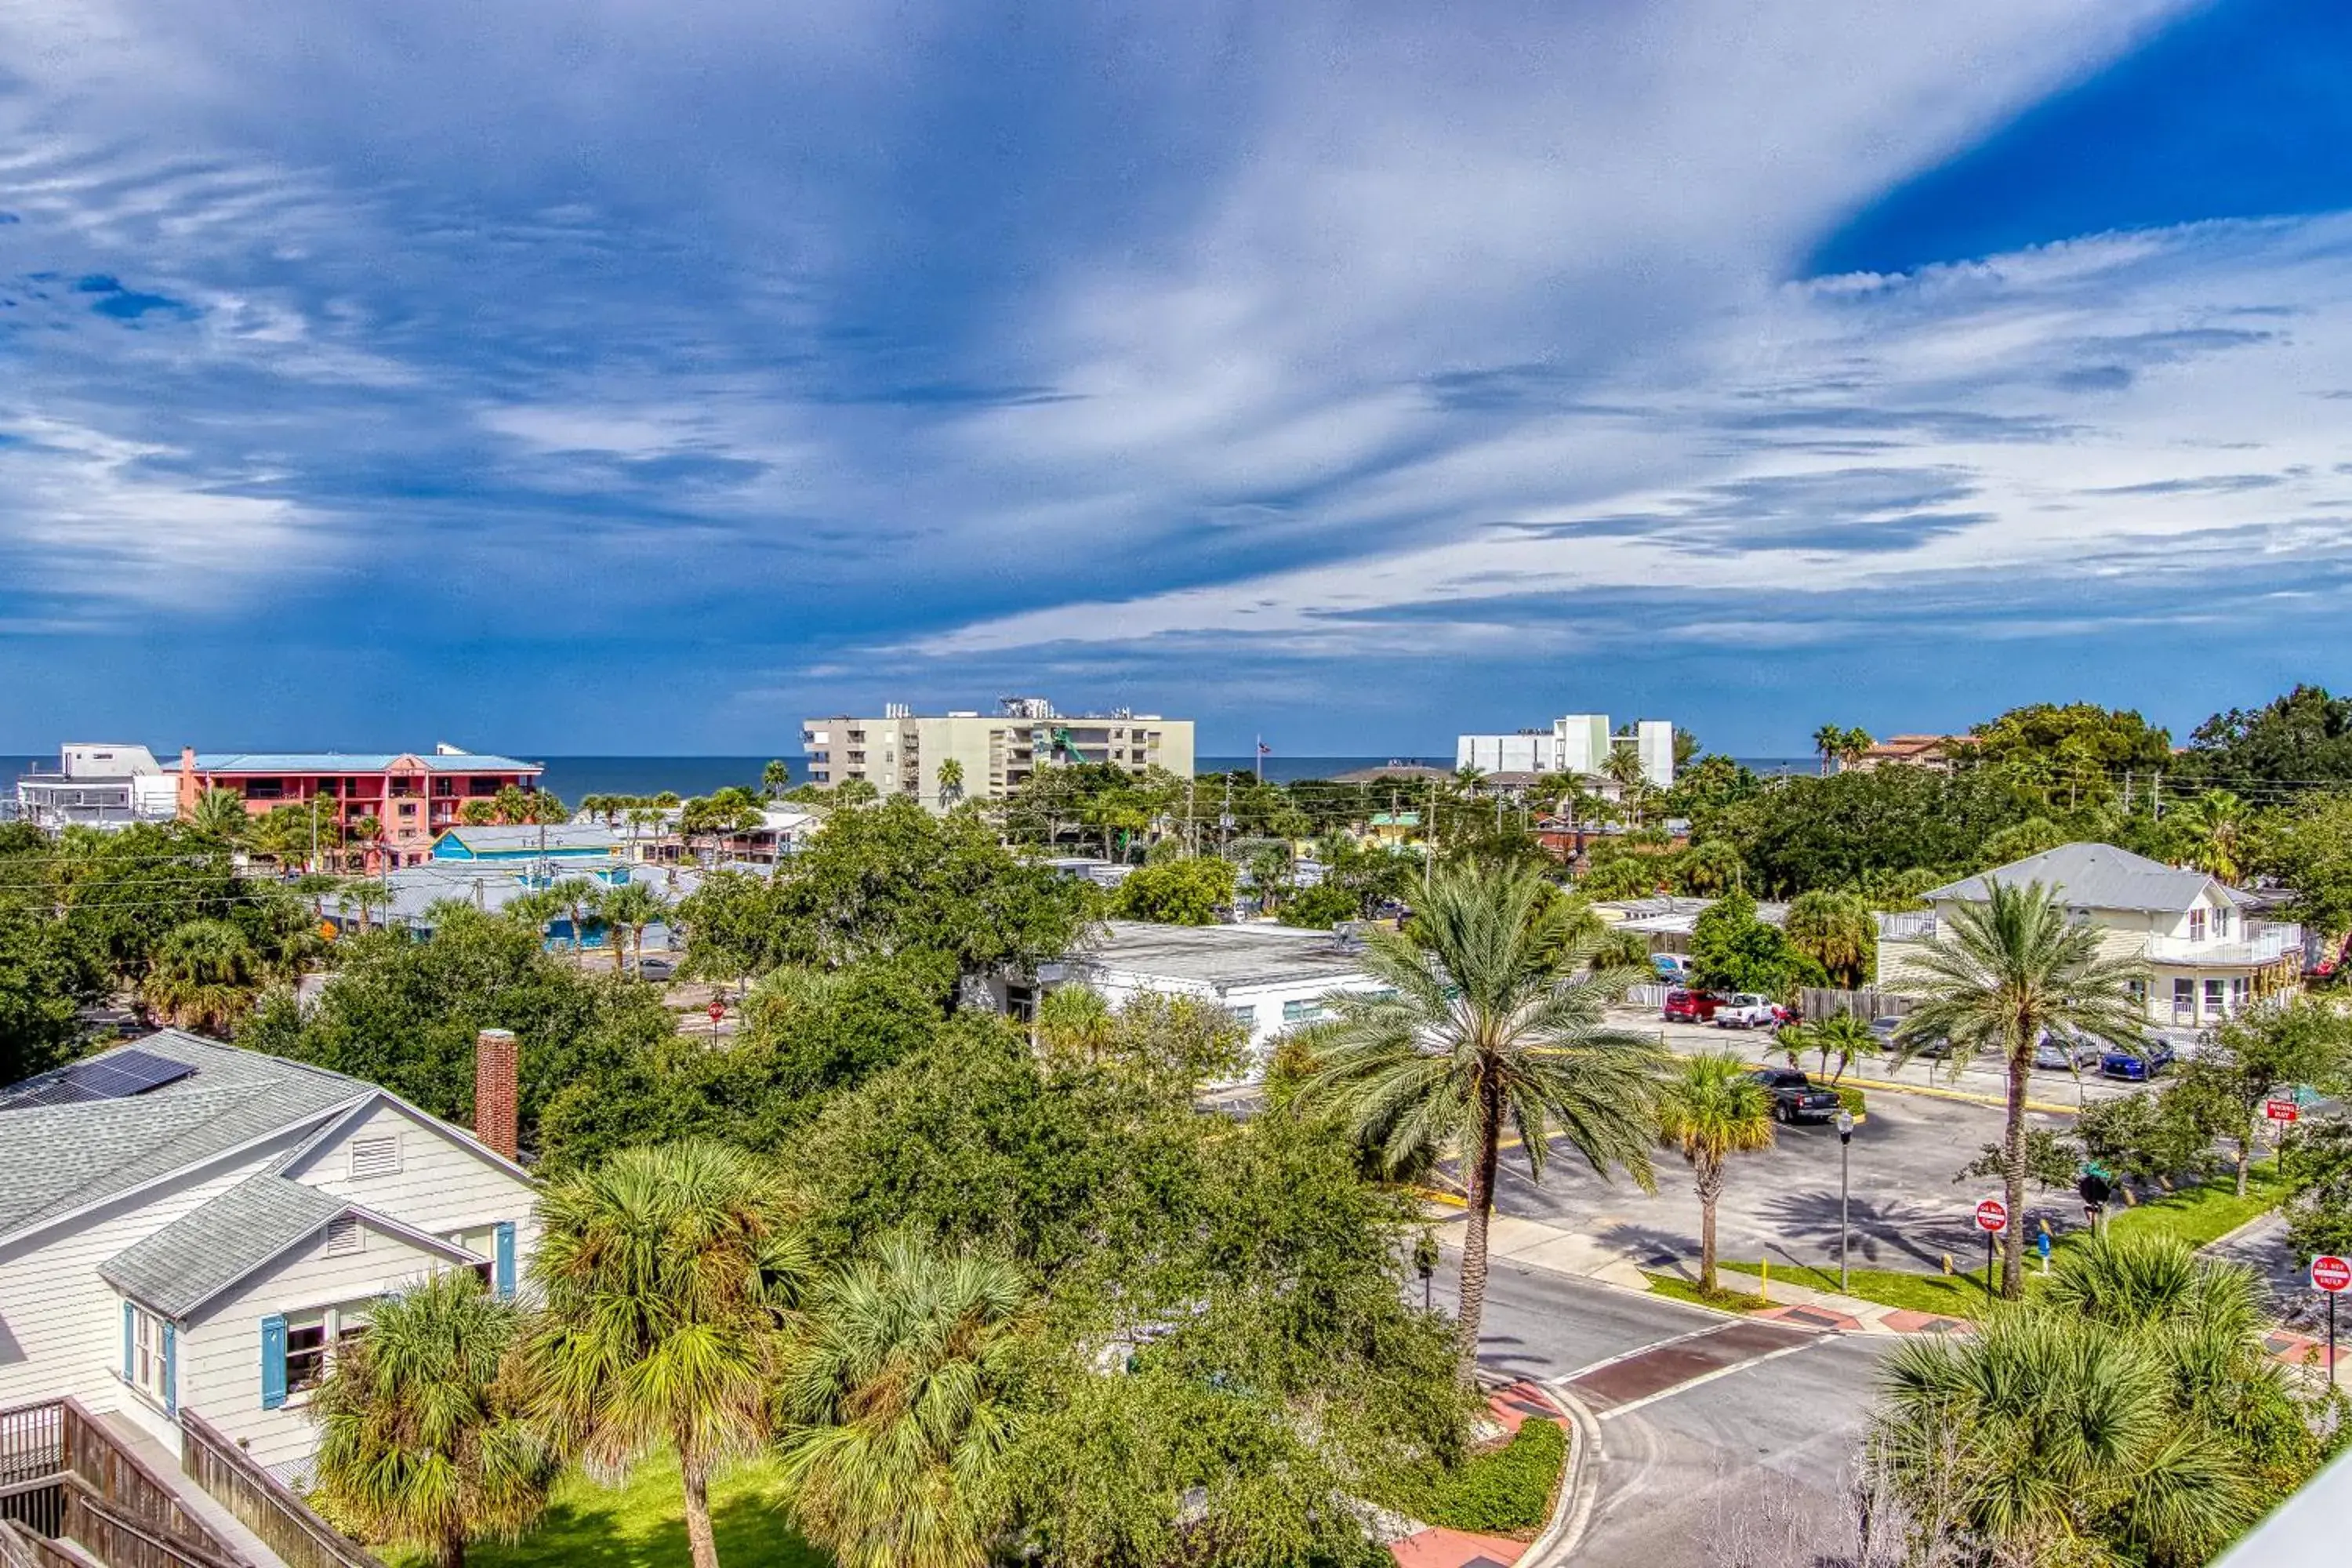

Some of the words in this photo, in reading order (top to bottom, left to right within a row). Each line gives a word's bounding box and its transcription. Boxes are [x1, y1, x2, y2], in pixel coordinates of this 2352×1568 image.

[2270, 1103, 2296, 1112] WRONG
[1981, 1217, 2000, 1225] ENTER
[2331, 1263, 2344, 1272] NOT
[2320, 1276, 2343, 1287] ENTER
